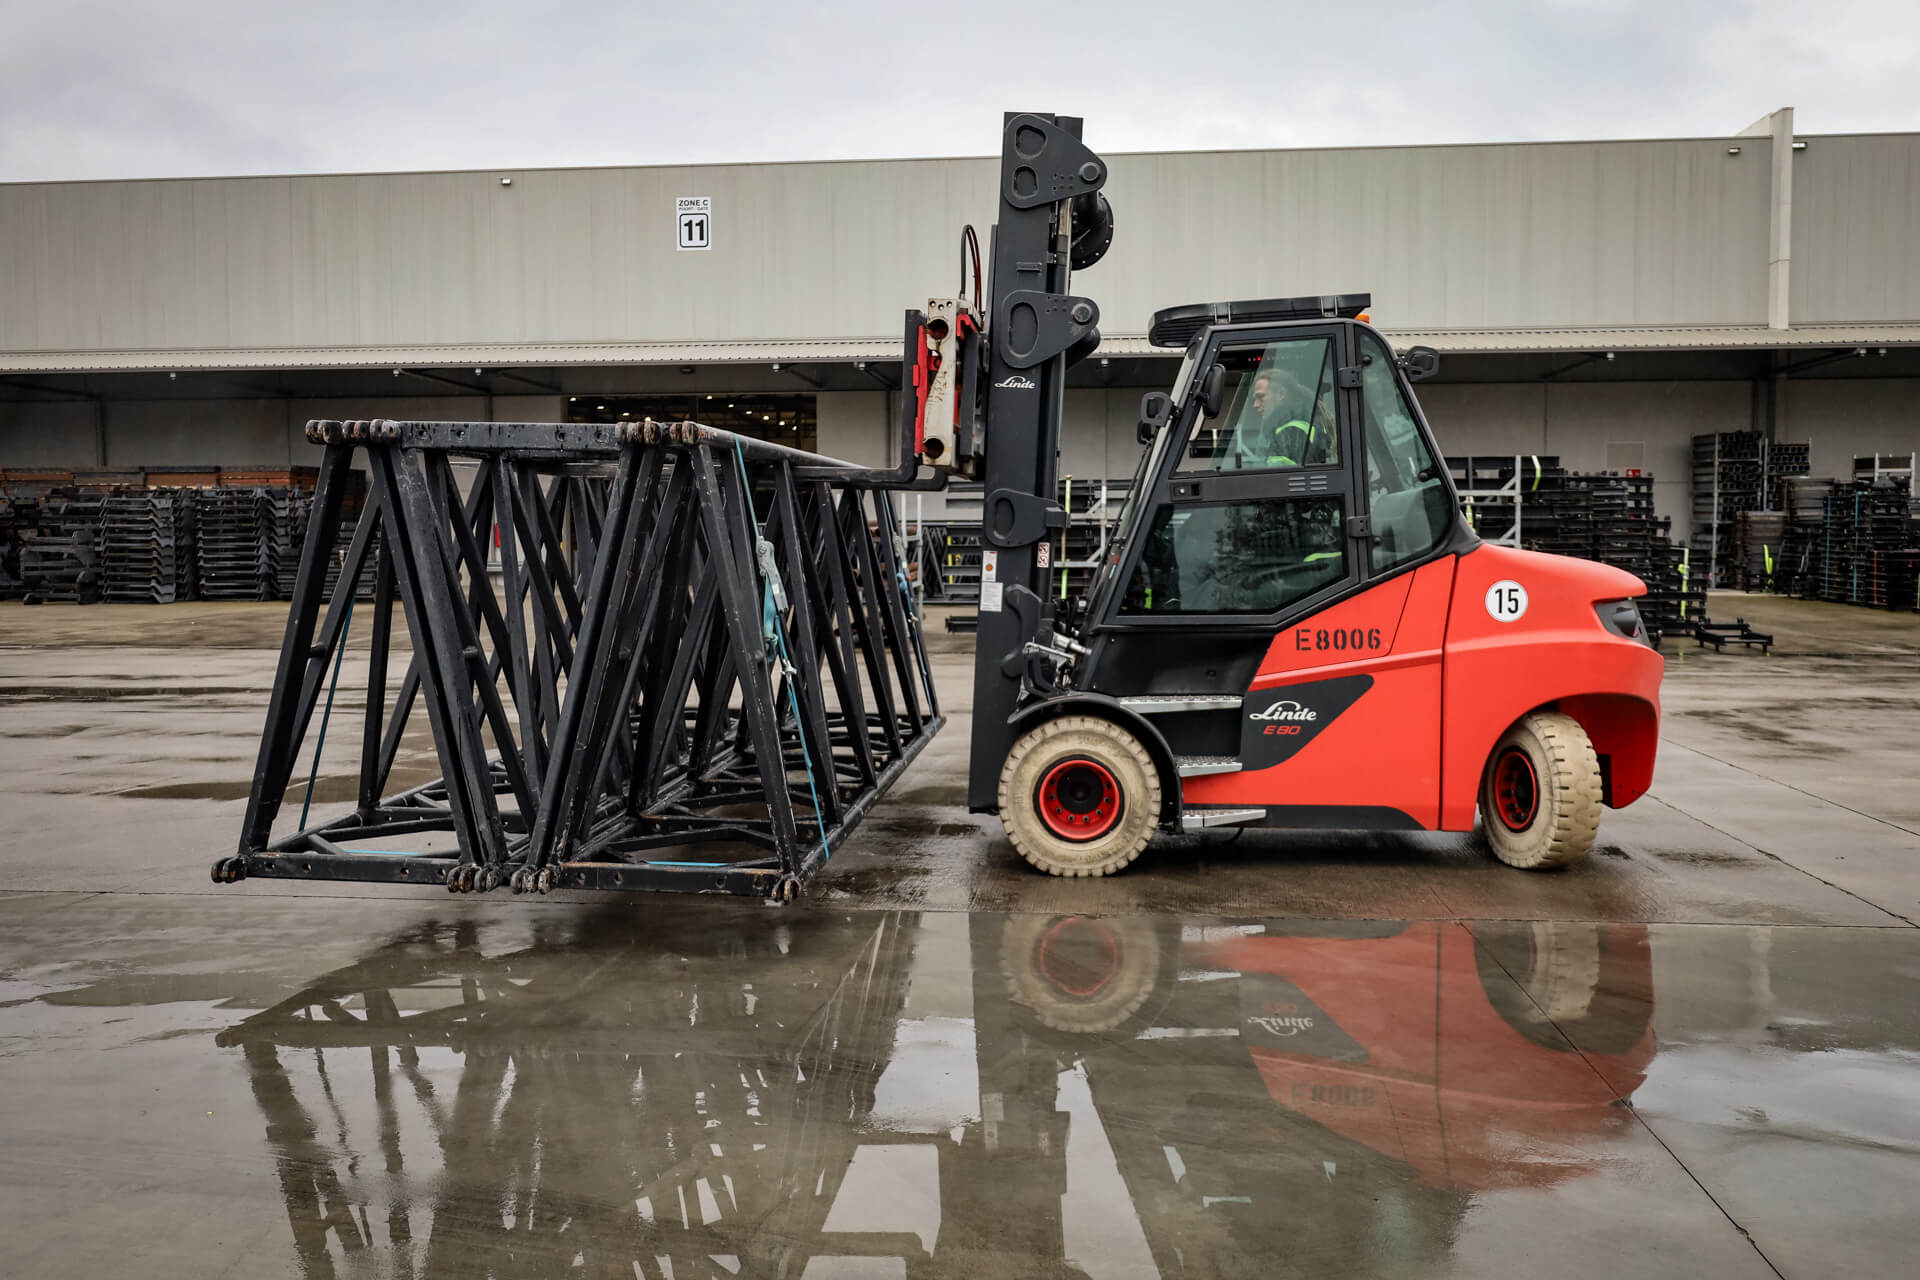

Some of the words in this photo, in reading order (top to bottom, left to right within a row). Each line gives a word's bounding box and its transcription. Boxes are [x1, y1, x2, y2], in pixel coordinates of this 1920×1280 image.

[684, 219, 704, 241] 11
[994, 375, 1036, 389] Linde
[1495, 588, 1519, 614] 15
[1296, 628, 1380, 651] E8006
[1249, 700, 1317, 721] Linde
